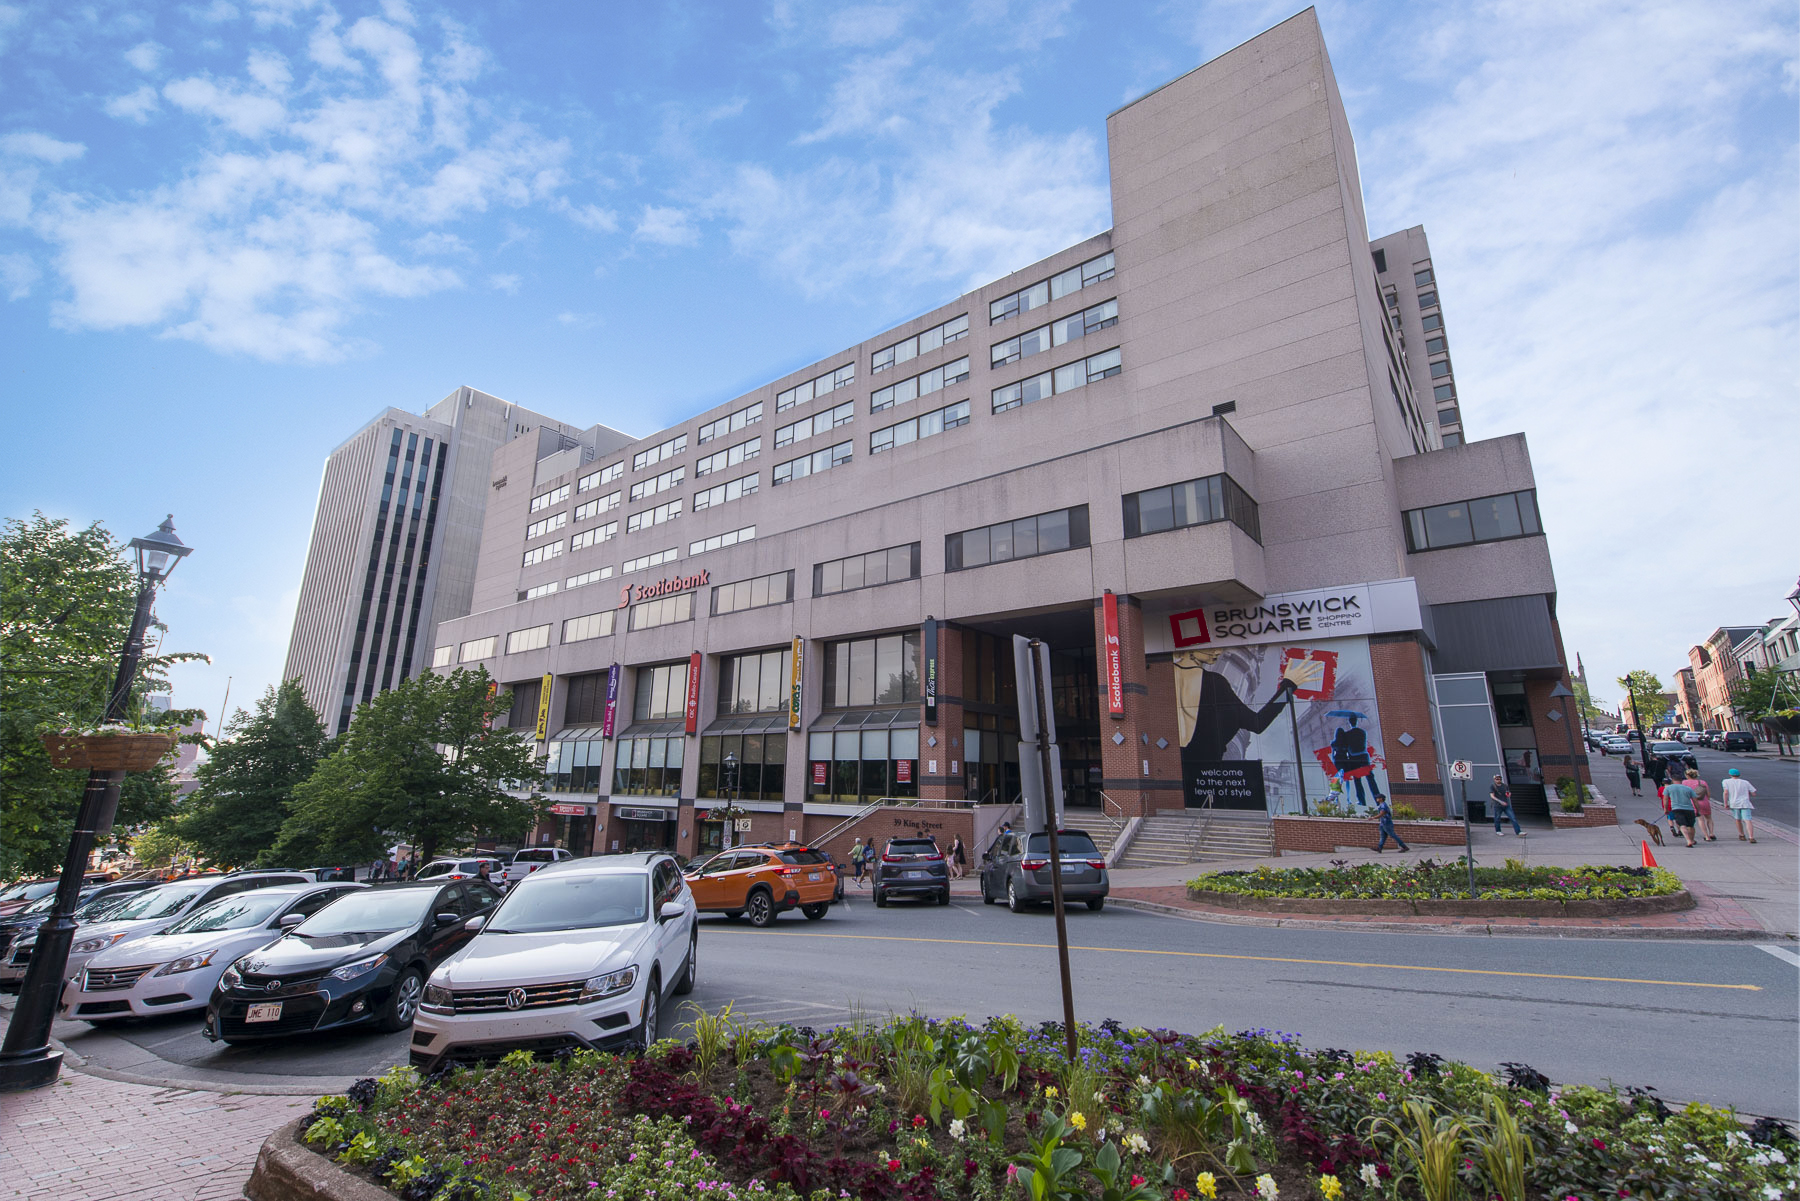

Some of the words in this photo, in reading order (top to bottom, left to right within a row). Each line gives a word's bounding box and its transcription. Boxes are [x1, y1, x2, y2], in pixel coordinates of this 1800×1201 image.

[635, 569, 709, 601] Scotiabank
[1214, 595, 1361, 623] BRUNSWICK
[1317, 612, 1362, 622] SHOPPING
[1214, 616, 1313, 639] SQUARE
[1318, 619, 1352, 629] CENTRE
[1110, 650, 1122, 708] Scotiabank
[1196, 778, 1206, 786] to
[1208, 778, 1223, 786] the
[1225, 778, 1246, 786] next
[1194, 787, 1215, 795] level
[1218, 787, 1228, 796] of
[1230, 788, 1252, 797] style
[894, 818, 902, 827] 39
[903, 819, 920, 829] King
[921, 820, 943, 829] Street
[248, 1009, 263, 1019] JME
[267, 1007, 280, 1017] 110
